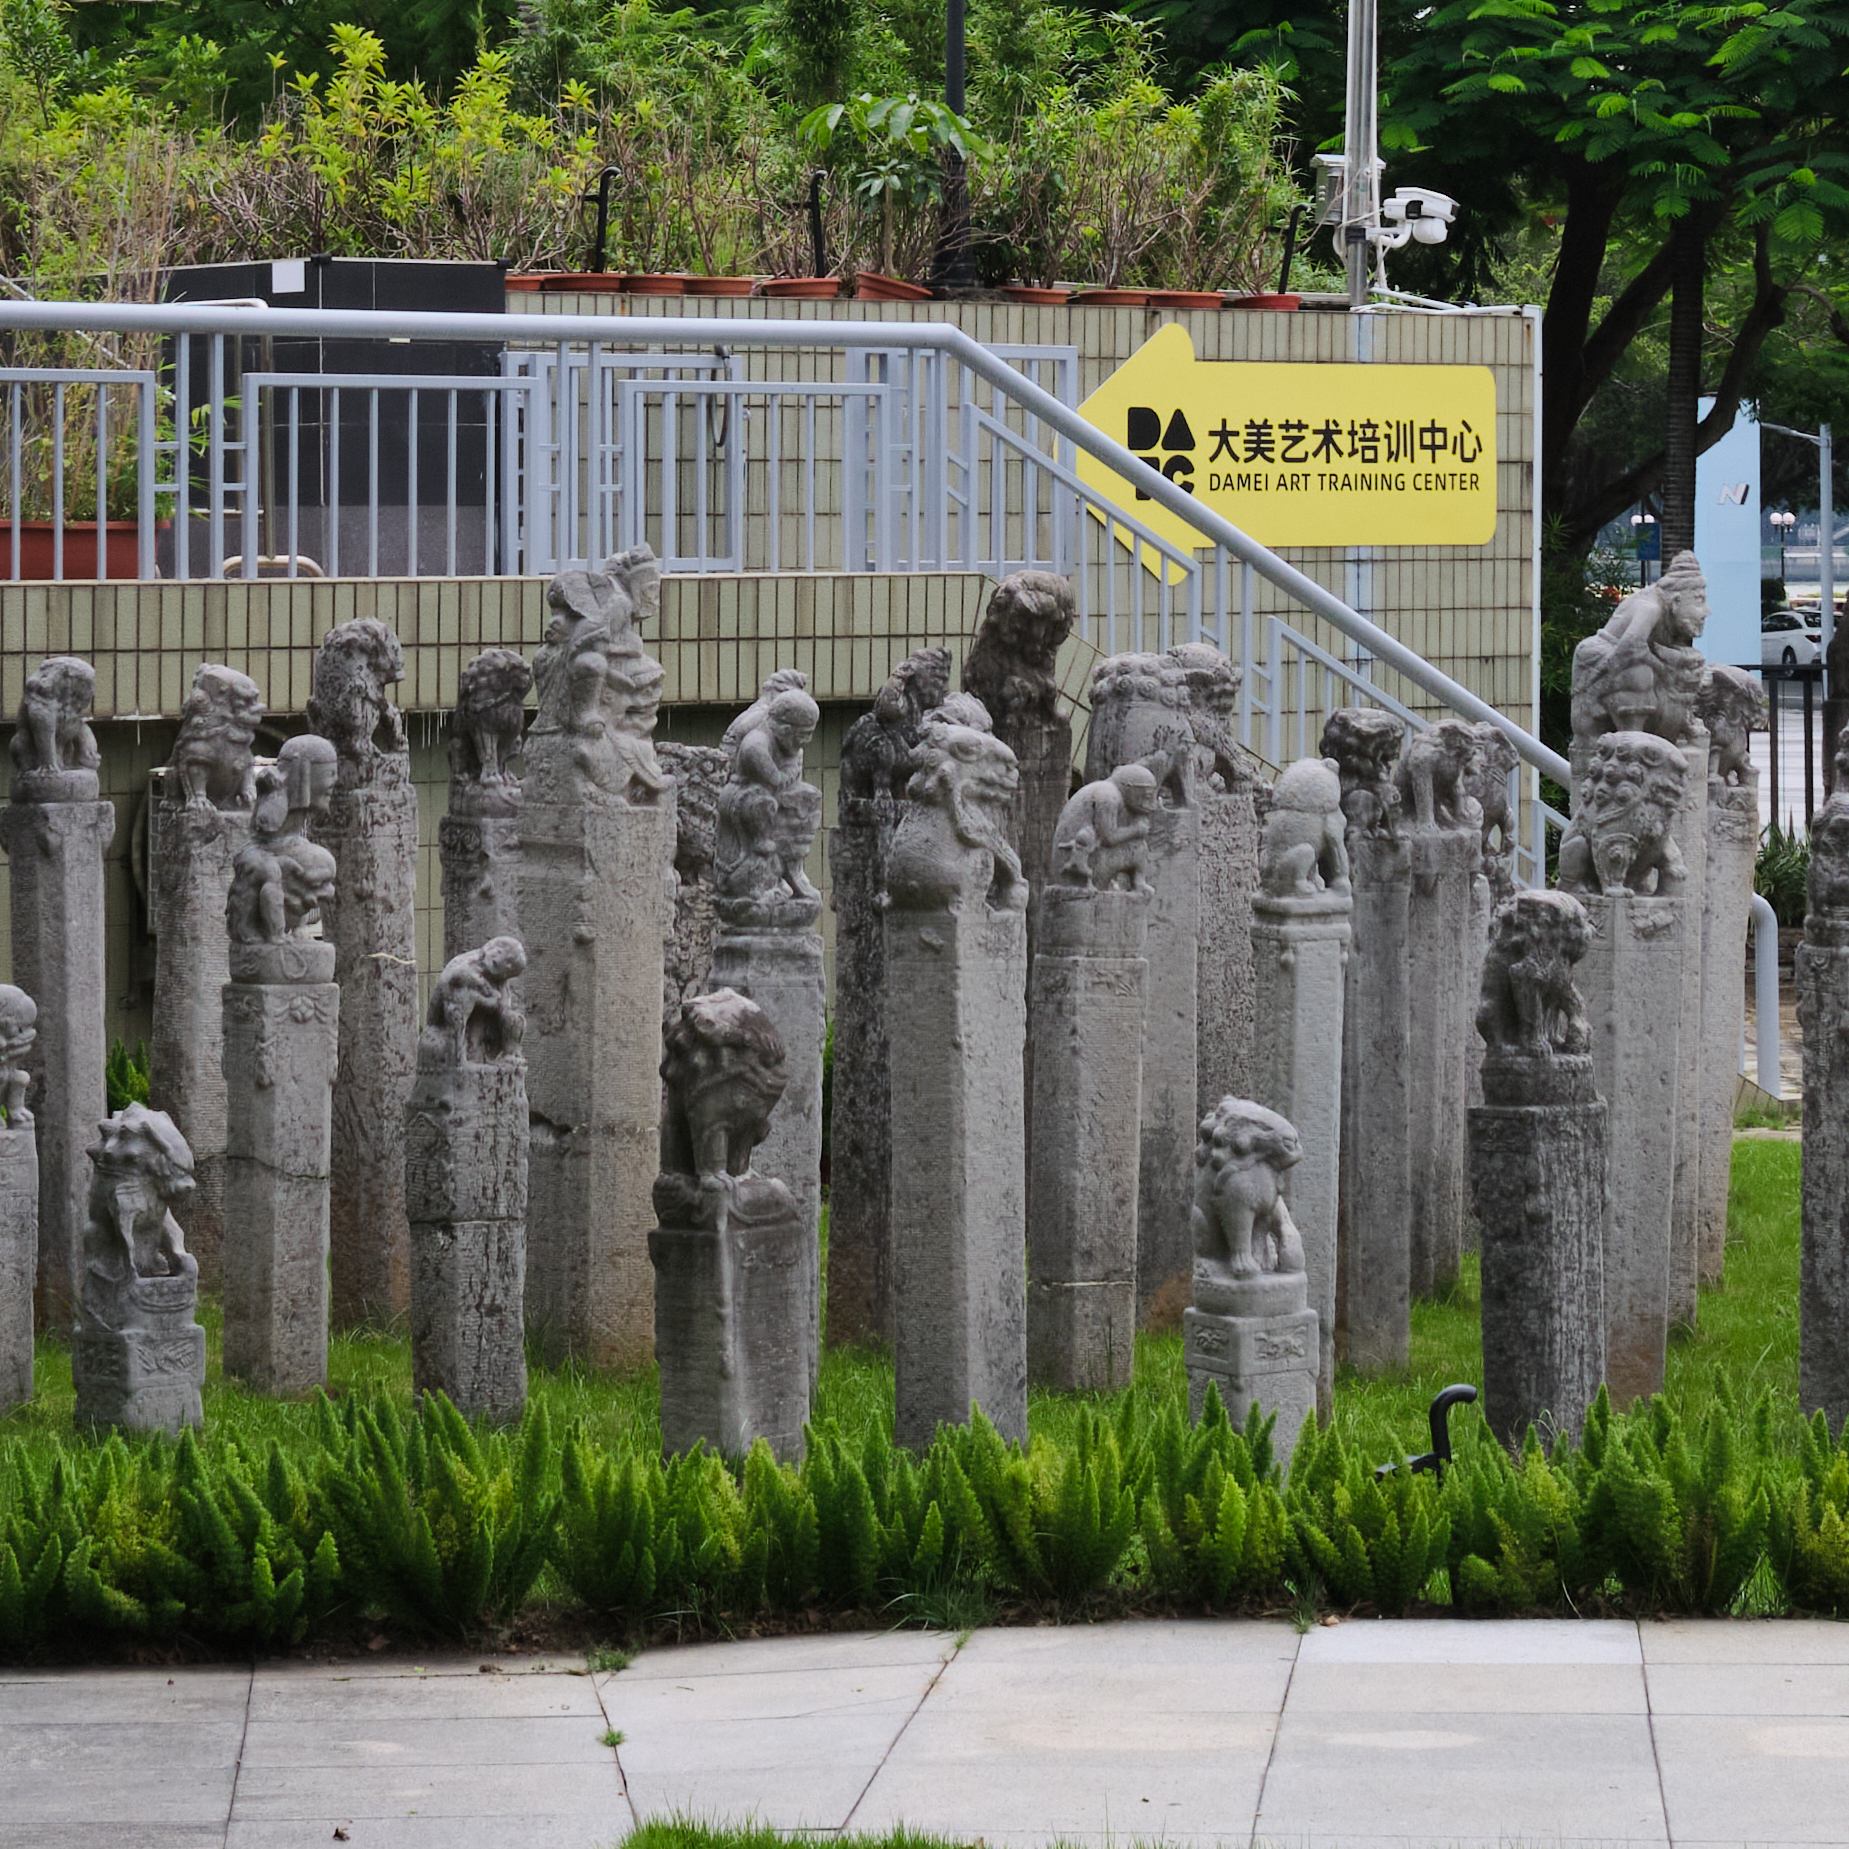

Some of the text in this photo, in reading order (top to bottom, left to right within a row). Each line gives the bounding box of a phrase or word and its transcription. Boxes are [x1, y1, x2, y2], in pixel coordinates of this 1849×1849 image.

[1208, 418, 1483, 464] 大美艺术培训中心
[1209, 473, 1480, 492] DAMEI ART TRAINING CENTER
